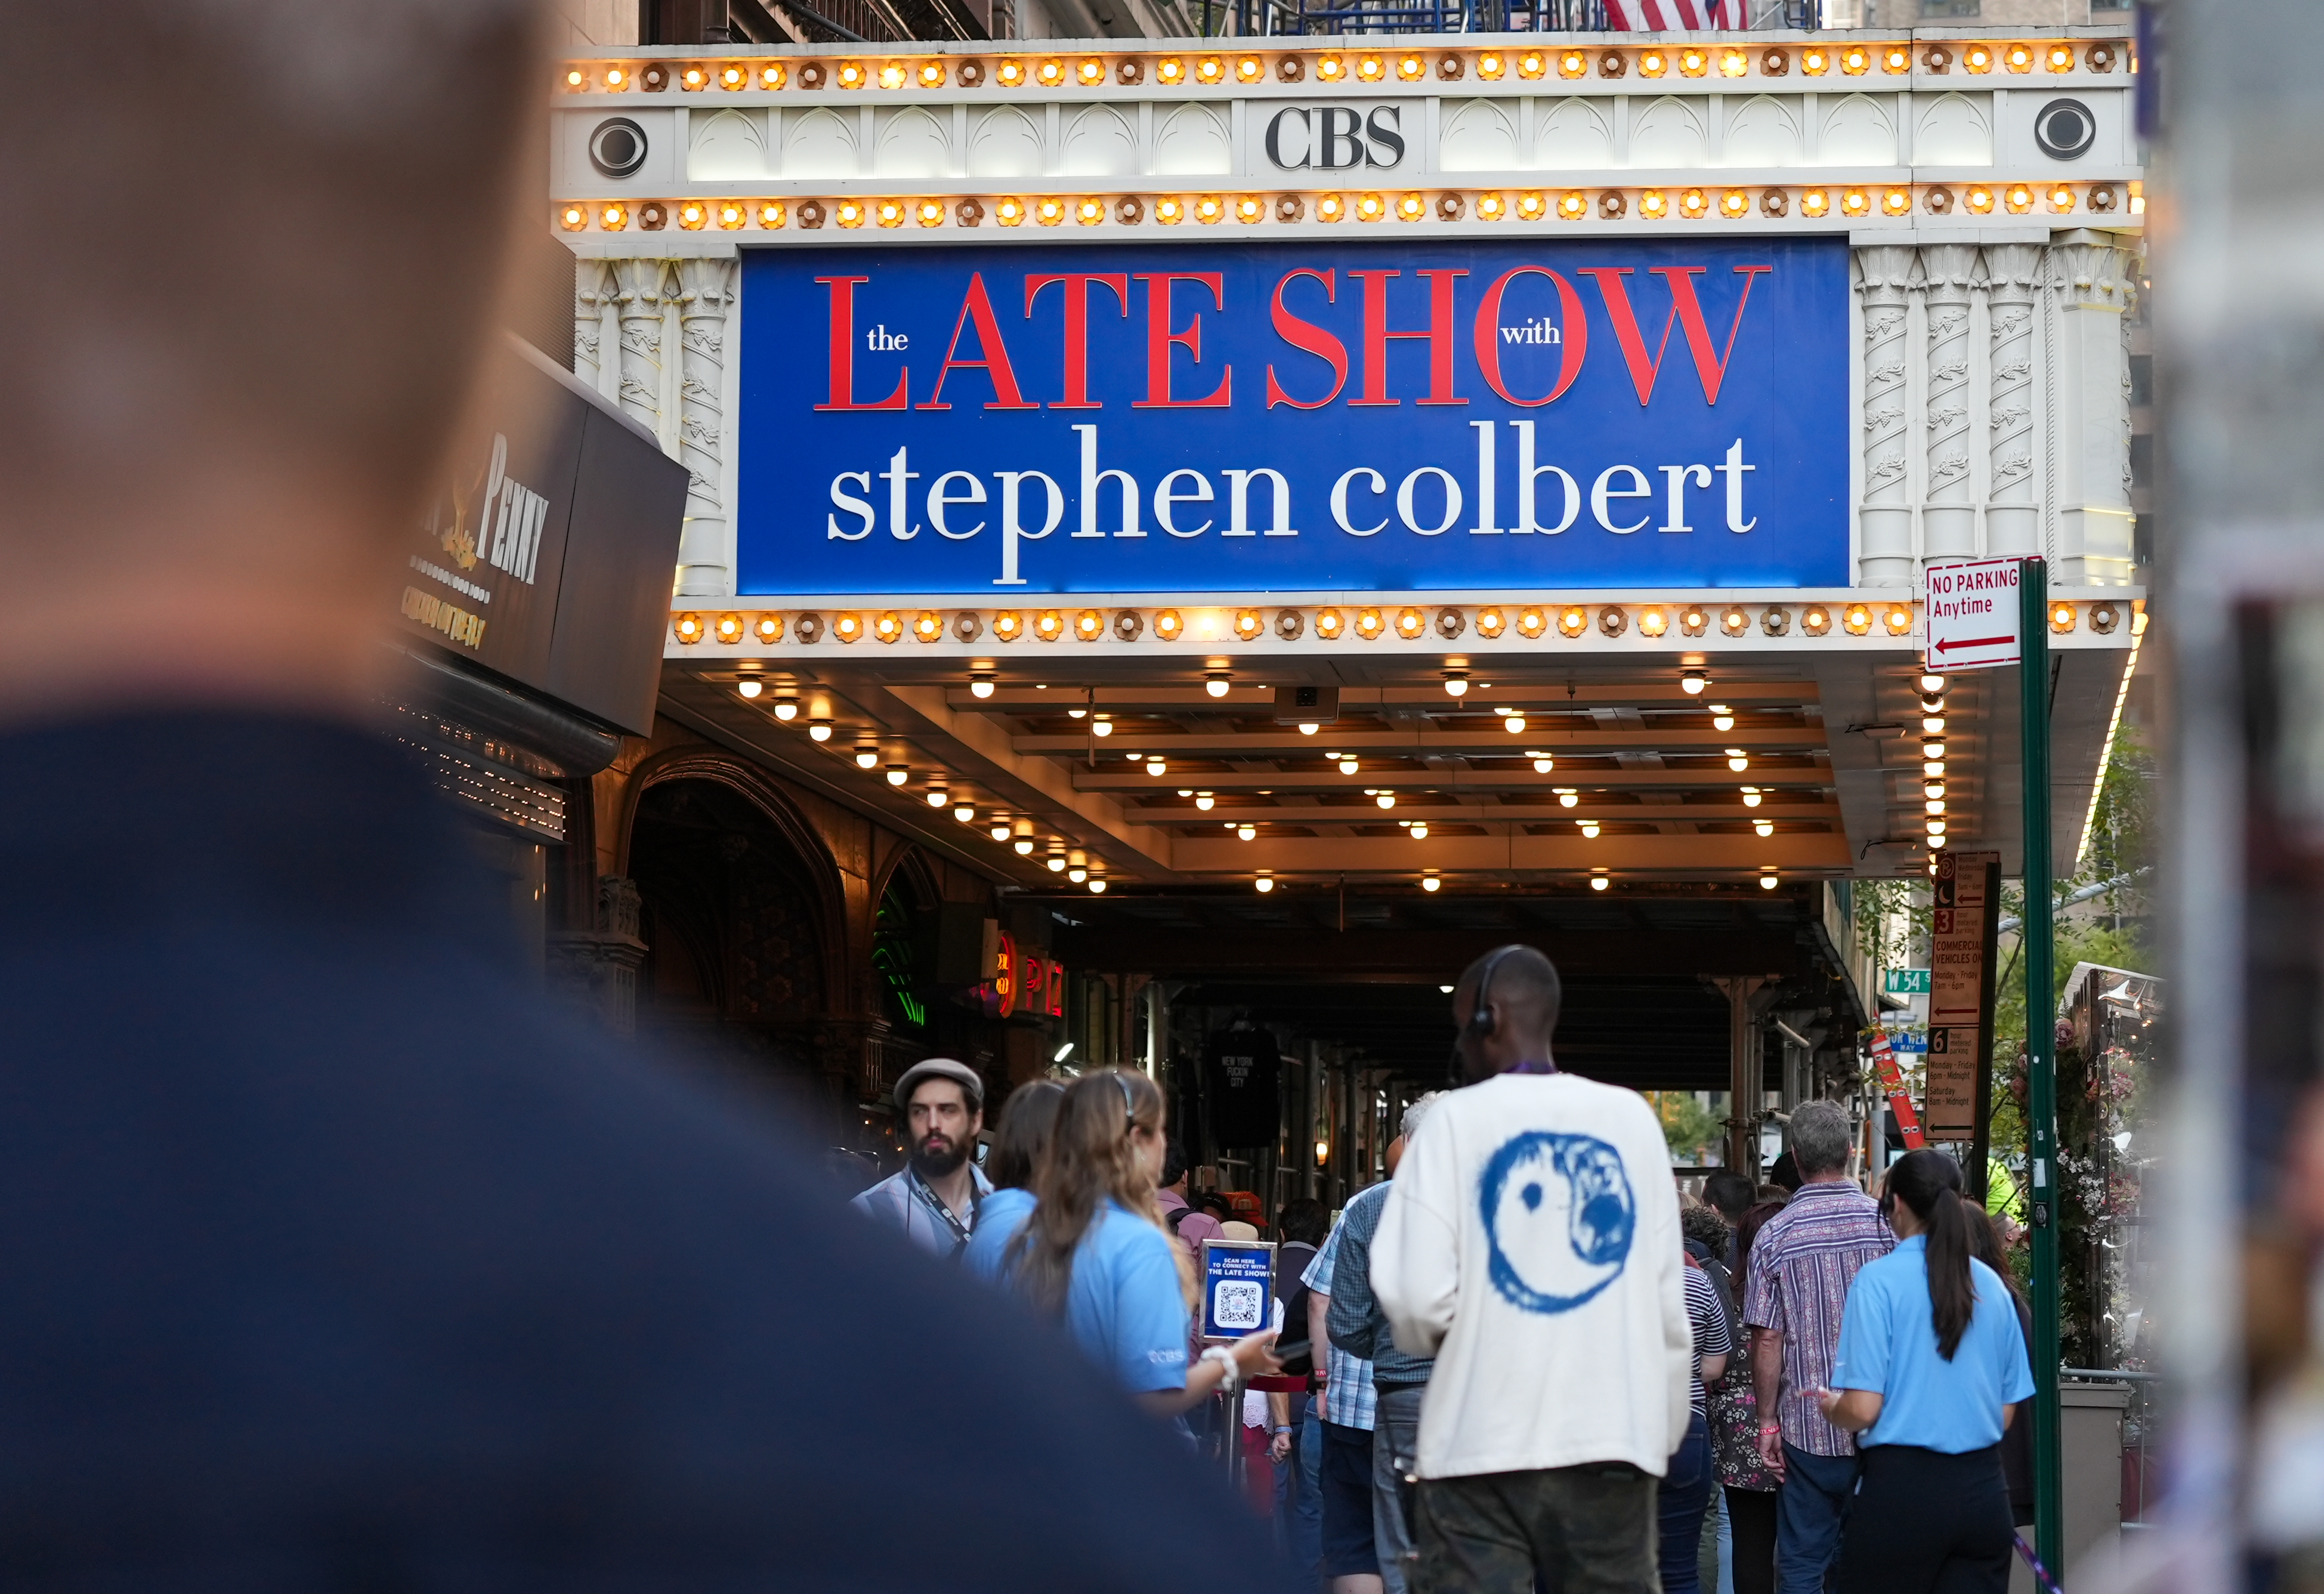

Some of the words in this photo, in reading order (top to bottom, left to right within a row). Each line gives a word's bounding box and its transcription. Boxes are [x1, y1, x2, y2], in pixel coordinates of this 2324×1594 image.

[1265, 106, 1405, 170] CBS
[814, 271, 1231, 411] LATE
[1266, 265, 1772, 410] SHOW
[867, 325, 908, 351] the
[1500, 318, 1561, 344] with
[828, 424, 1299, 585] stephen
[1330, 420, 1757, 537] colbert
[1933, 576, 1951, 594] NO
[1957, 569, 2017, 592] PARKING
[1934, 597, 1992, 620] Anytime
[1939, 911, 1949, 932] 3
[1936, 941, 1983, 951] COMMERCIAL
[1936, 954, 1970, 963] VEHICLES
[1889, 971, 1899, 990] W
[1904, 972, 1920, 991] 54
[1925, 974, 1930, 983] S
[1934, 971, 1956, 981] Monday
[1961, 971, 1978, 980] Friday
[1933, 1030, 1943, 1052] 6
[1222, 1056, 1235, 1066] NEW
[1237, 1057, 1253, 1067] YORK
[1231, 1077, 1244, 1087] CITY
[1930, 1072, 1942, 1080] 6pm
[1947, 1071, 1970, 1081] Midnight
[1929, 1087, 1955, 1095] Saturday
[1946, 1098, 1969, 1107] Midnight
